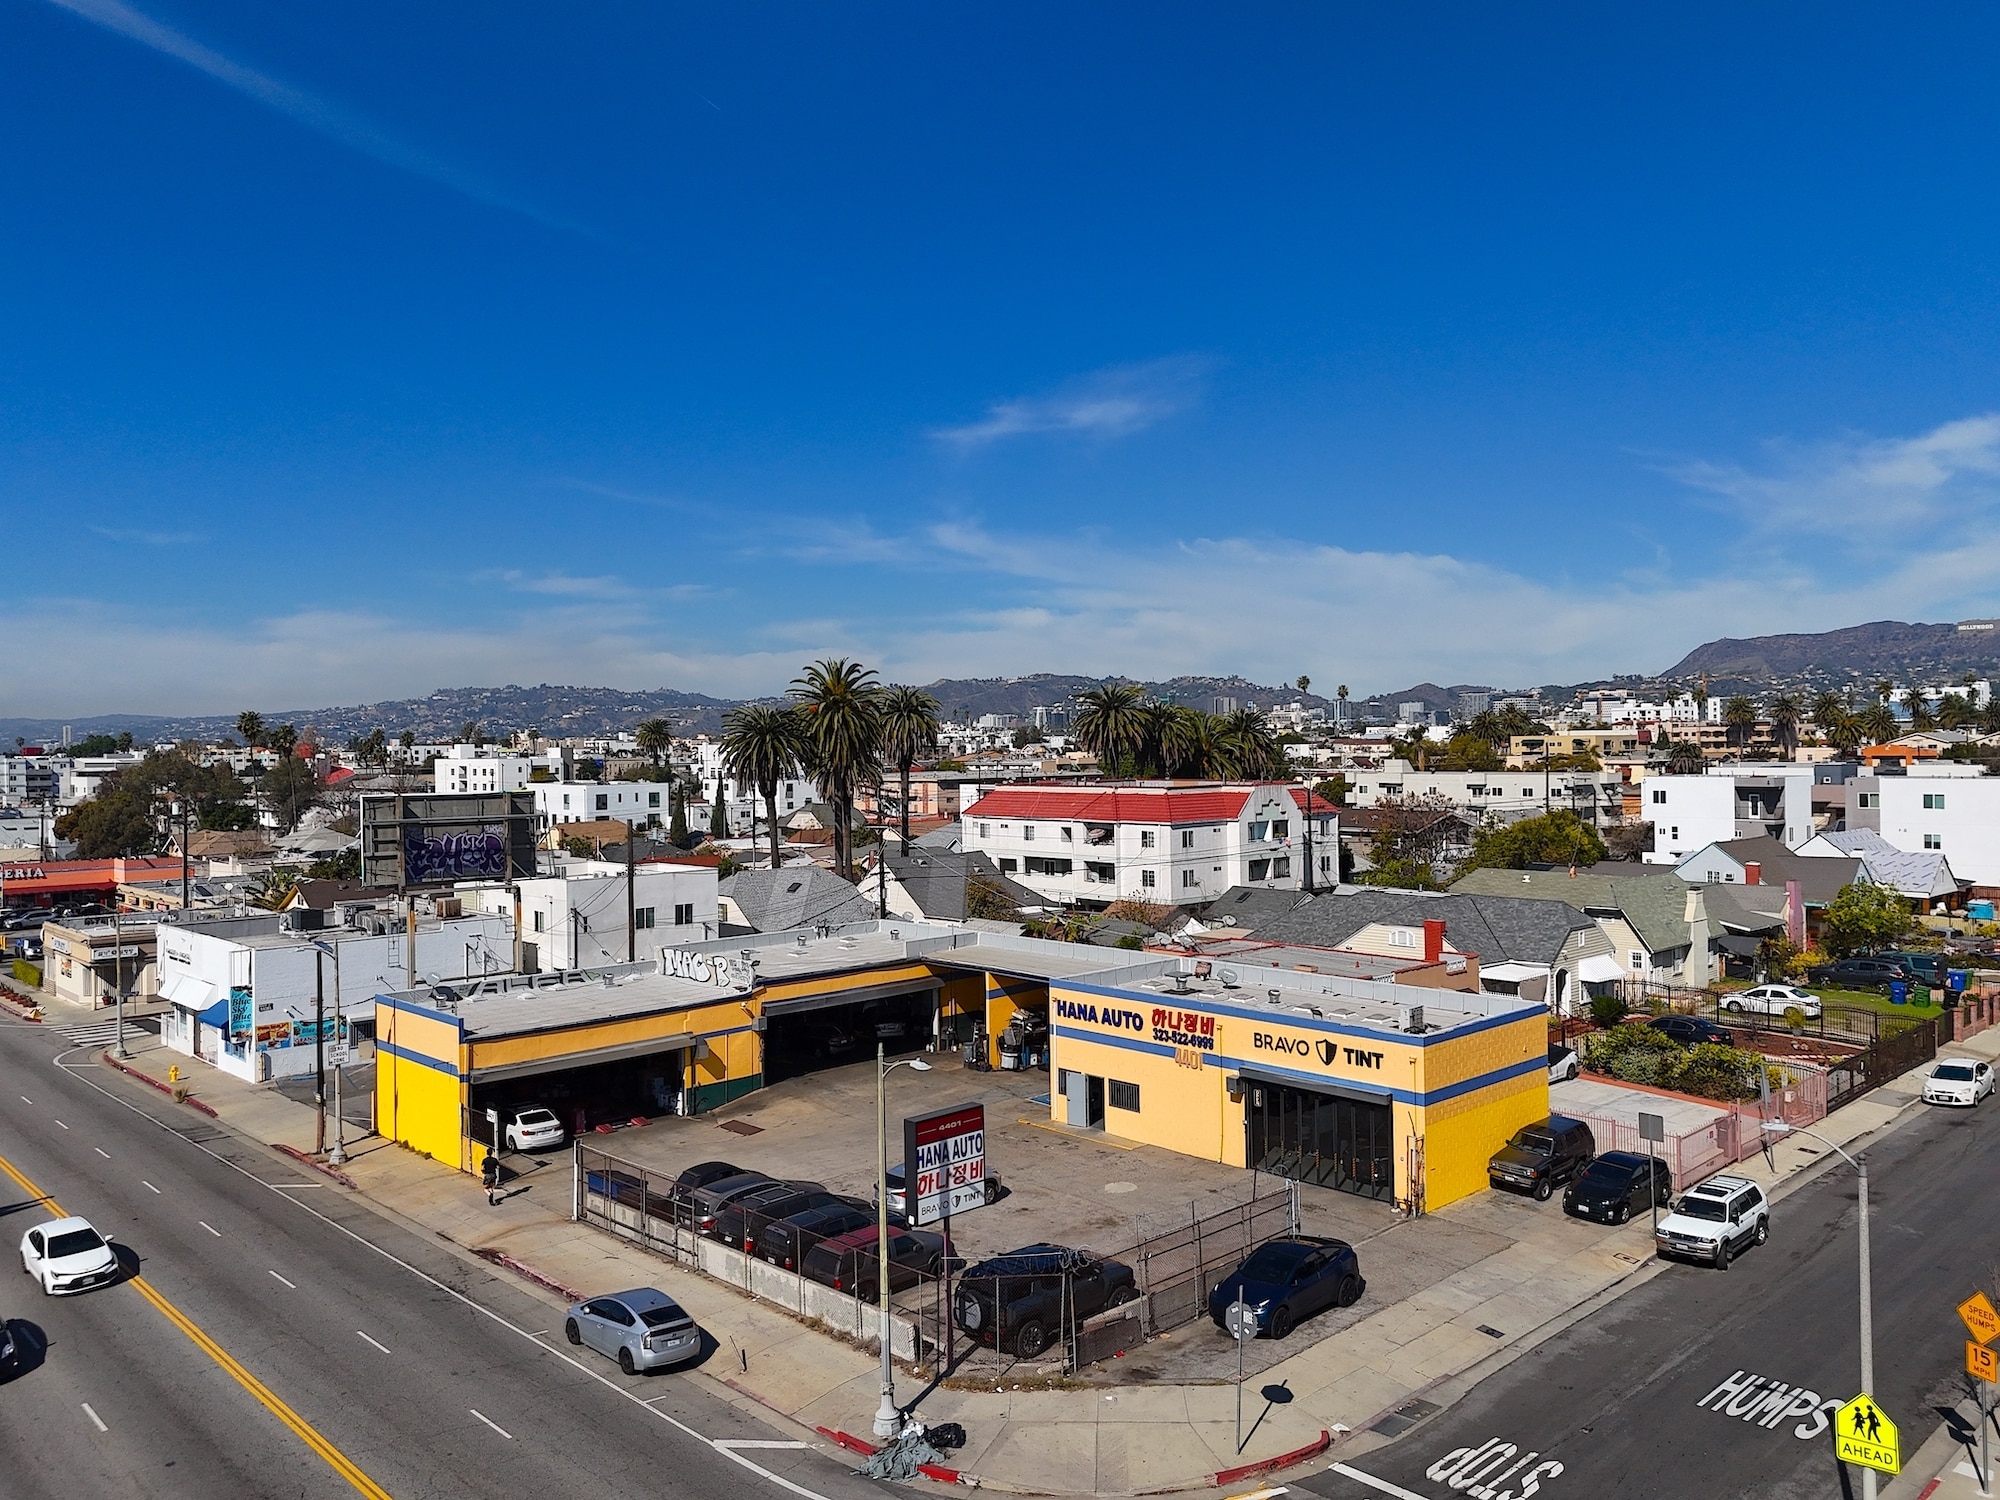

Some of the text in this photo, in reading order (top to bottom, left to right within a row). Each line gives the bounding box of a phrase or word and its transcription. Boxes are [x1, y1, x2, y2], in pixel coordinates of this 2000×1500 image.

[1057, 1000, 1144, 1031] HANA AUTO
[1152, 1009, 1215, 1036] 하나정비
[1174, 1048, 1203, 1071] 4401
[1254, 1032, 1384, 1069] BRAVO TINT
[939, 1120, 961, 1131] 4401
[916, 1133, 983, 1169] HANA AUTO
[917, 1159, 983, 1195] 하나정비
[921, 1190, 981, 1216] BRAVO TINT
[1967, 1315, 1996, 1332] HUMPS
[1968, 1305, 1994, 1321] SPEED
[1973, 1348, 1991, 1366] 15
[1973, 1365, 1990, 1377] MPH
[1696, 1370, 1847, 1440] HUMPS
[1843, 1443, 1893, 1465] AHEAD
[1425, 1436, 1565, 1500] STOP
